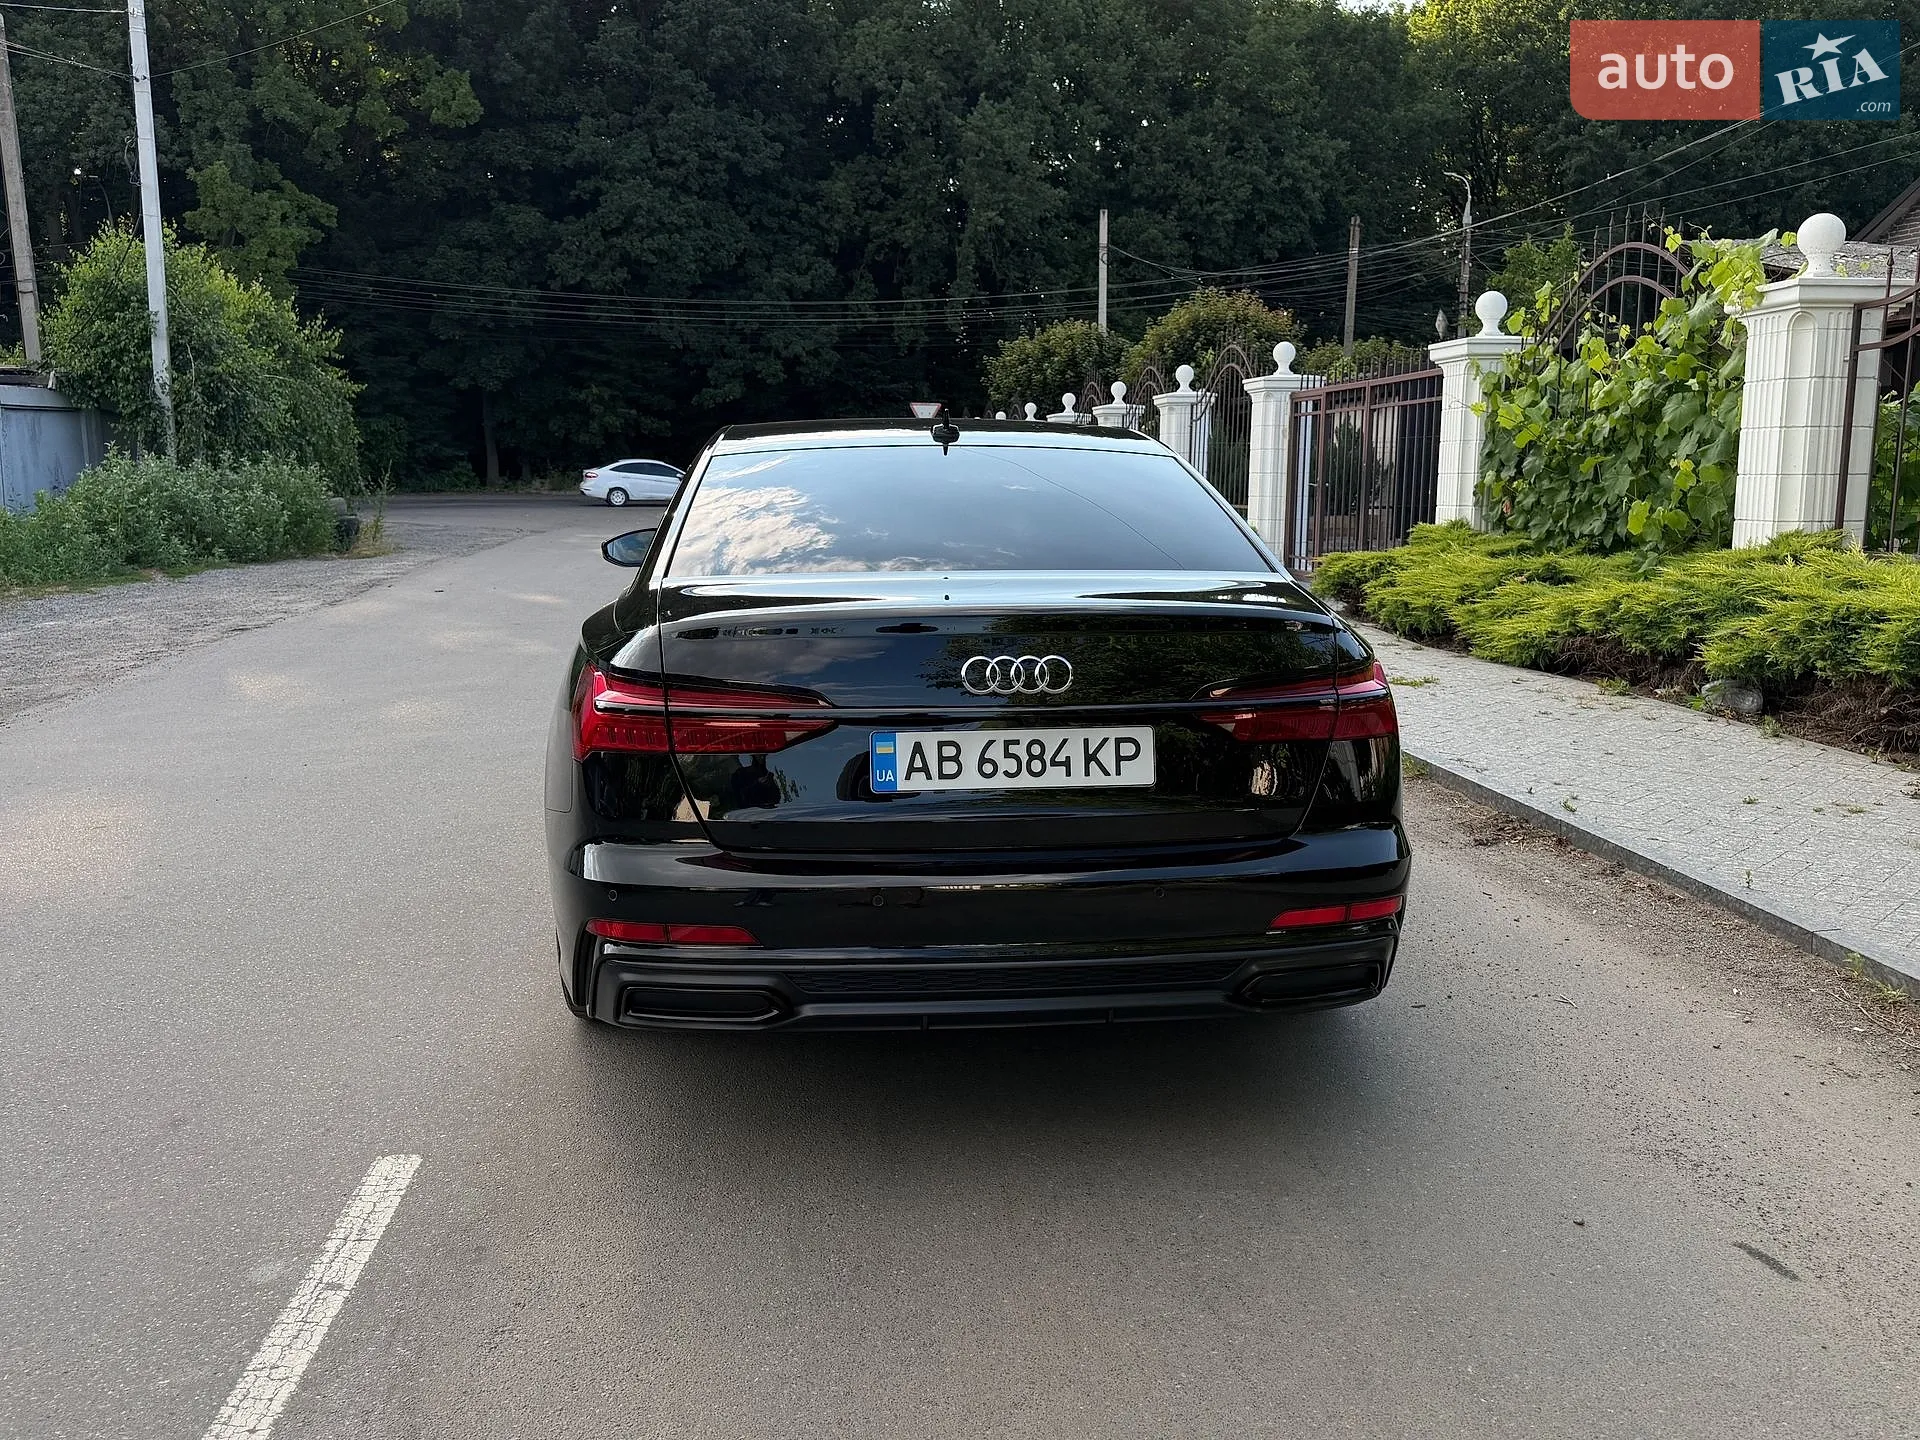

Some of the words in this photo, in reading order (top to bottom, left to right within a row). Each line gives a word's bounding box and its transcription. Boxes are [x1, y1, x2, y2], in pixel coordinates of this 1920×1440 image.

[904, 740, 963, 781] AB
[977, 737, 1071, 779] 6584
[1083, 736, 1141, 777] KP
[876, 769, 894, 782] UA
